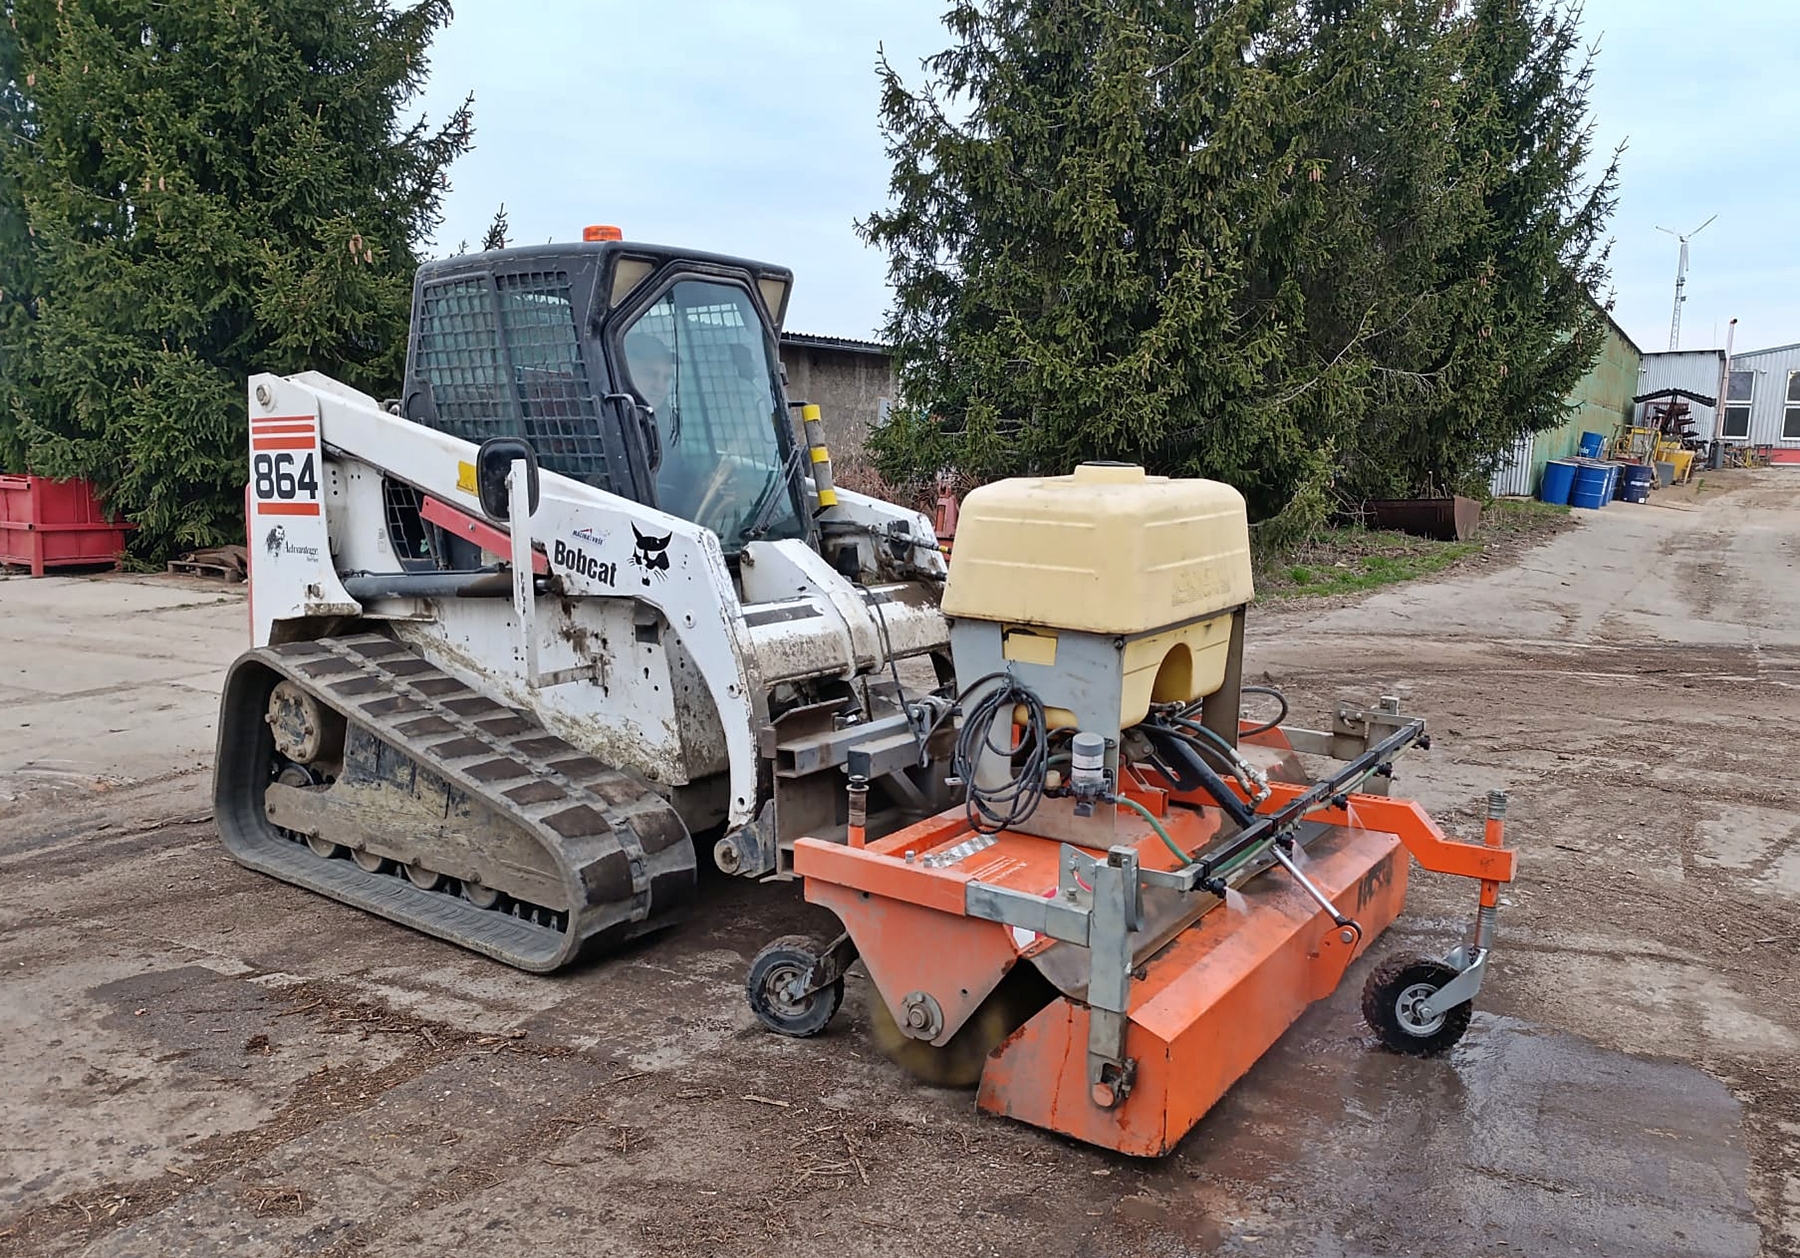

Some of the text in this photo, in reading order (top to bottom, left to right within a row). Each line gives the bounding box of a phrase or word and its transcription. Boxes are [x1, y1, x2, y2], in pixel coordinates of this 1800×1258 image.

[254, 452, 318, 499] 864
[285, 540, 319, 556] Advantage
[554, 539, 617, 587] Bobcat
